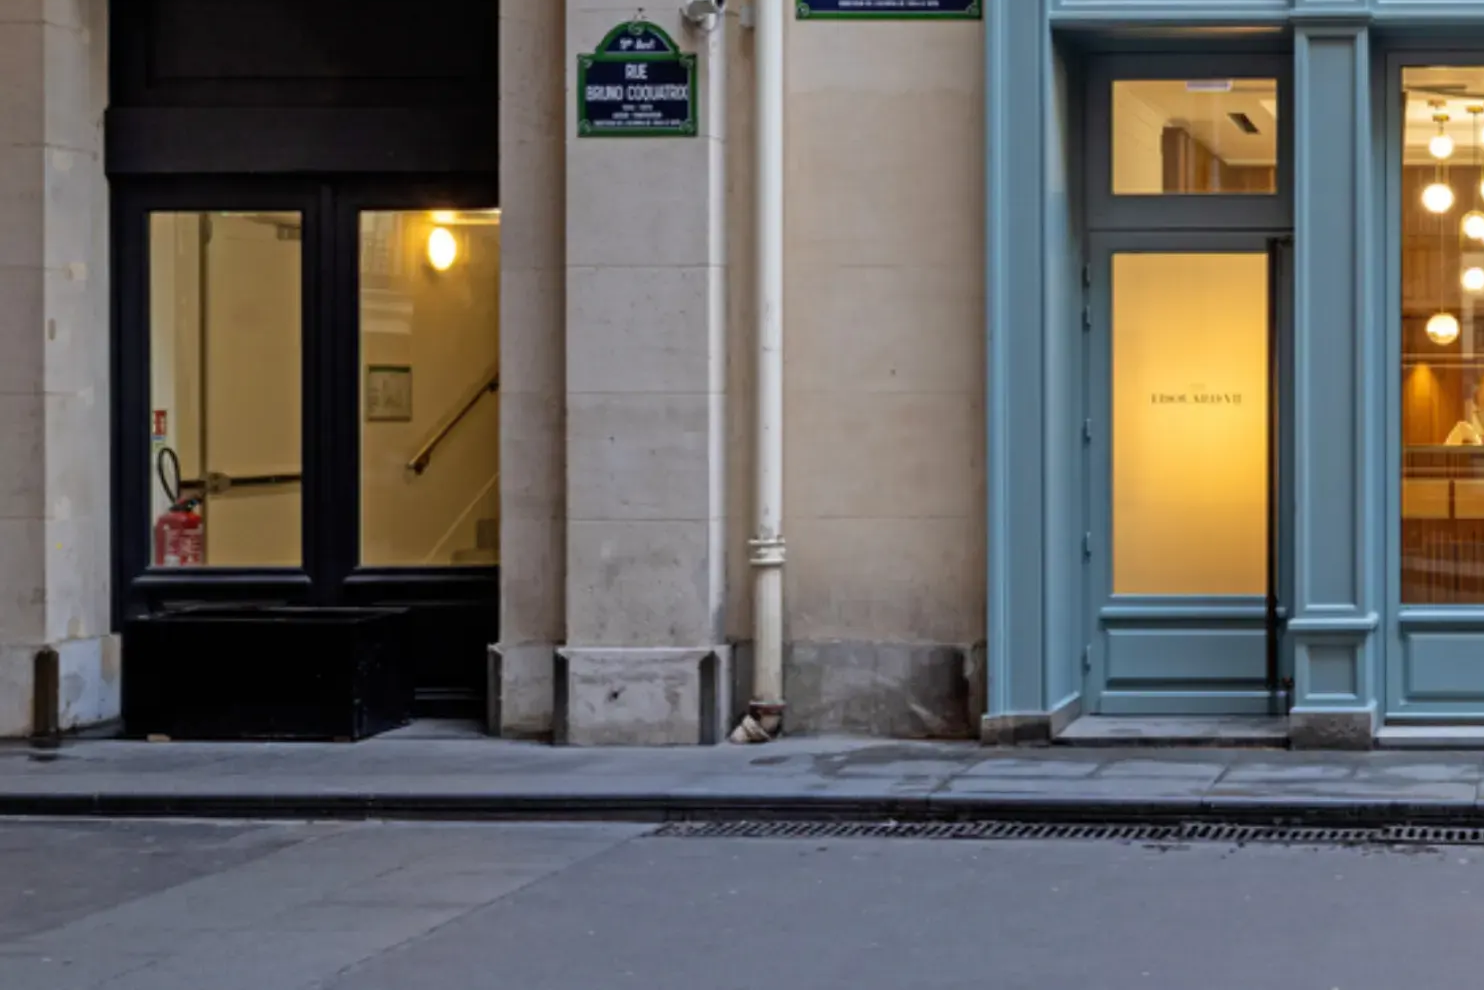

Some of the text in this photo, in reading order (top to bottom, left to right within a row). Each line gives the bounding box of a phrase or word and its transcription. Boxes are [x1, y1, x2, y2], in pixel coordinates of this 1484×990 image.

[624, 63, 648, 80] RUE
[586, 84, 689, 102] BRUNO COQUATRIX
